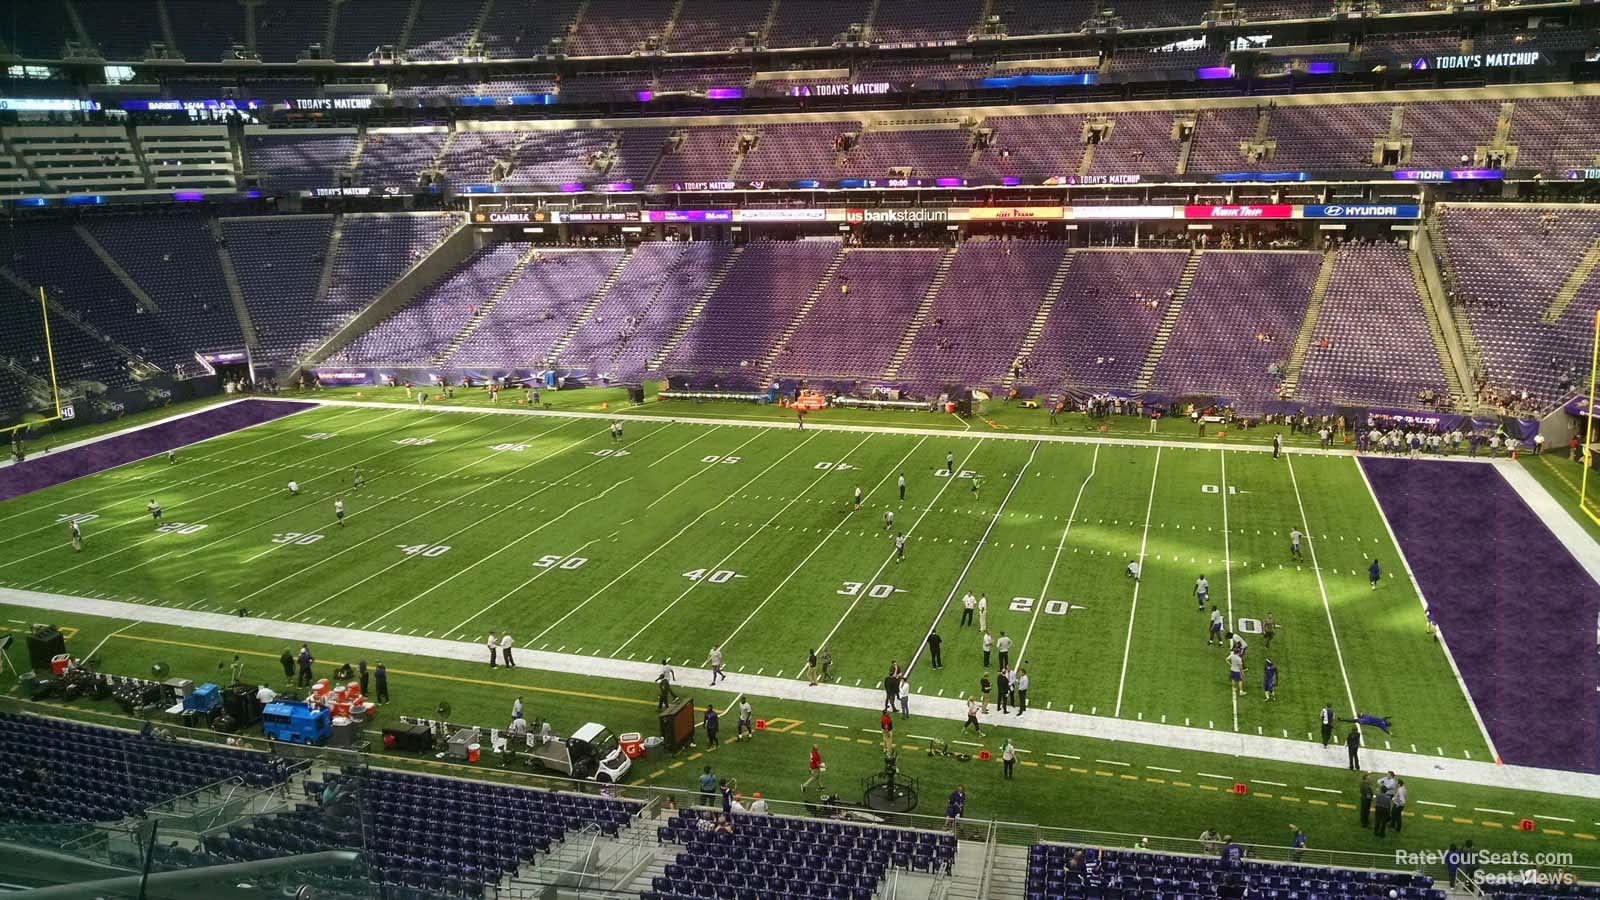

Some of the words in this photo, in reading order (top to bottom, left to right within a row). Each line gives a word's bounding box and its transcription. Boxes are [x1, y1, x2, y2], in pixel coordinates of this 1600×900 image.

[1436, 55, 1481, 69] TODAY'S
[1486, 52, 1539, 67] MATCHUP
[816, 85, 849, 96] TODAY'S
[852, 82, 890, 94] MATCHUP
[296, 99, 331, 109] TODAY'S
[333, 98, 372, 109] MATCHUP
[1080, 175, 1107, 184] TODAY'S
[1109, 174, 1140, 184] MATCHUP
[316, 188, 341, 196] TODAY'S
[342, 187, 371, 196] MATCHUP
[684, 182, 708, 191] TODAY'S
[709, 181, 736, 190] MATCHUP
[490, 212, 529, 222] CAMBRIA
[1345, 207, 1396, 215] HYUNDAI
[61, 407, 74, 418] 40
[401, 544, 452, 557] 40
[532, 555, 588, 570] 50
[682, 568, 736, 583] 40
[836, 581, 895, 598] 30
[1008, 597, 1069, 616] 20
